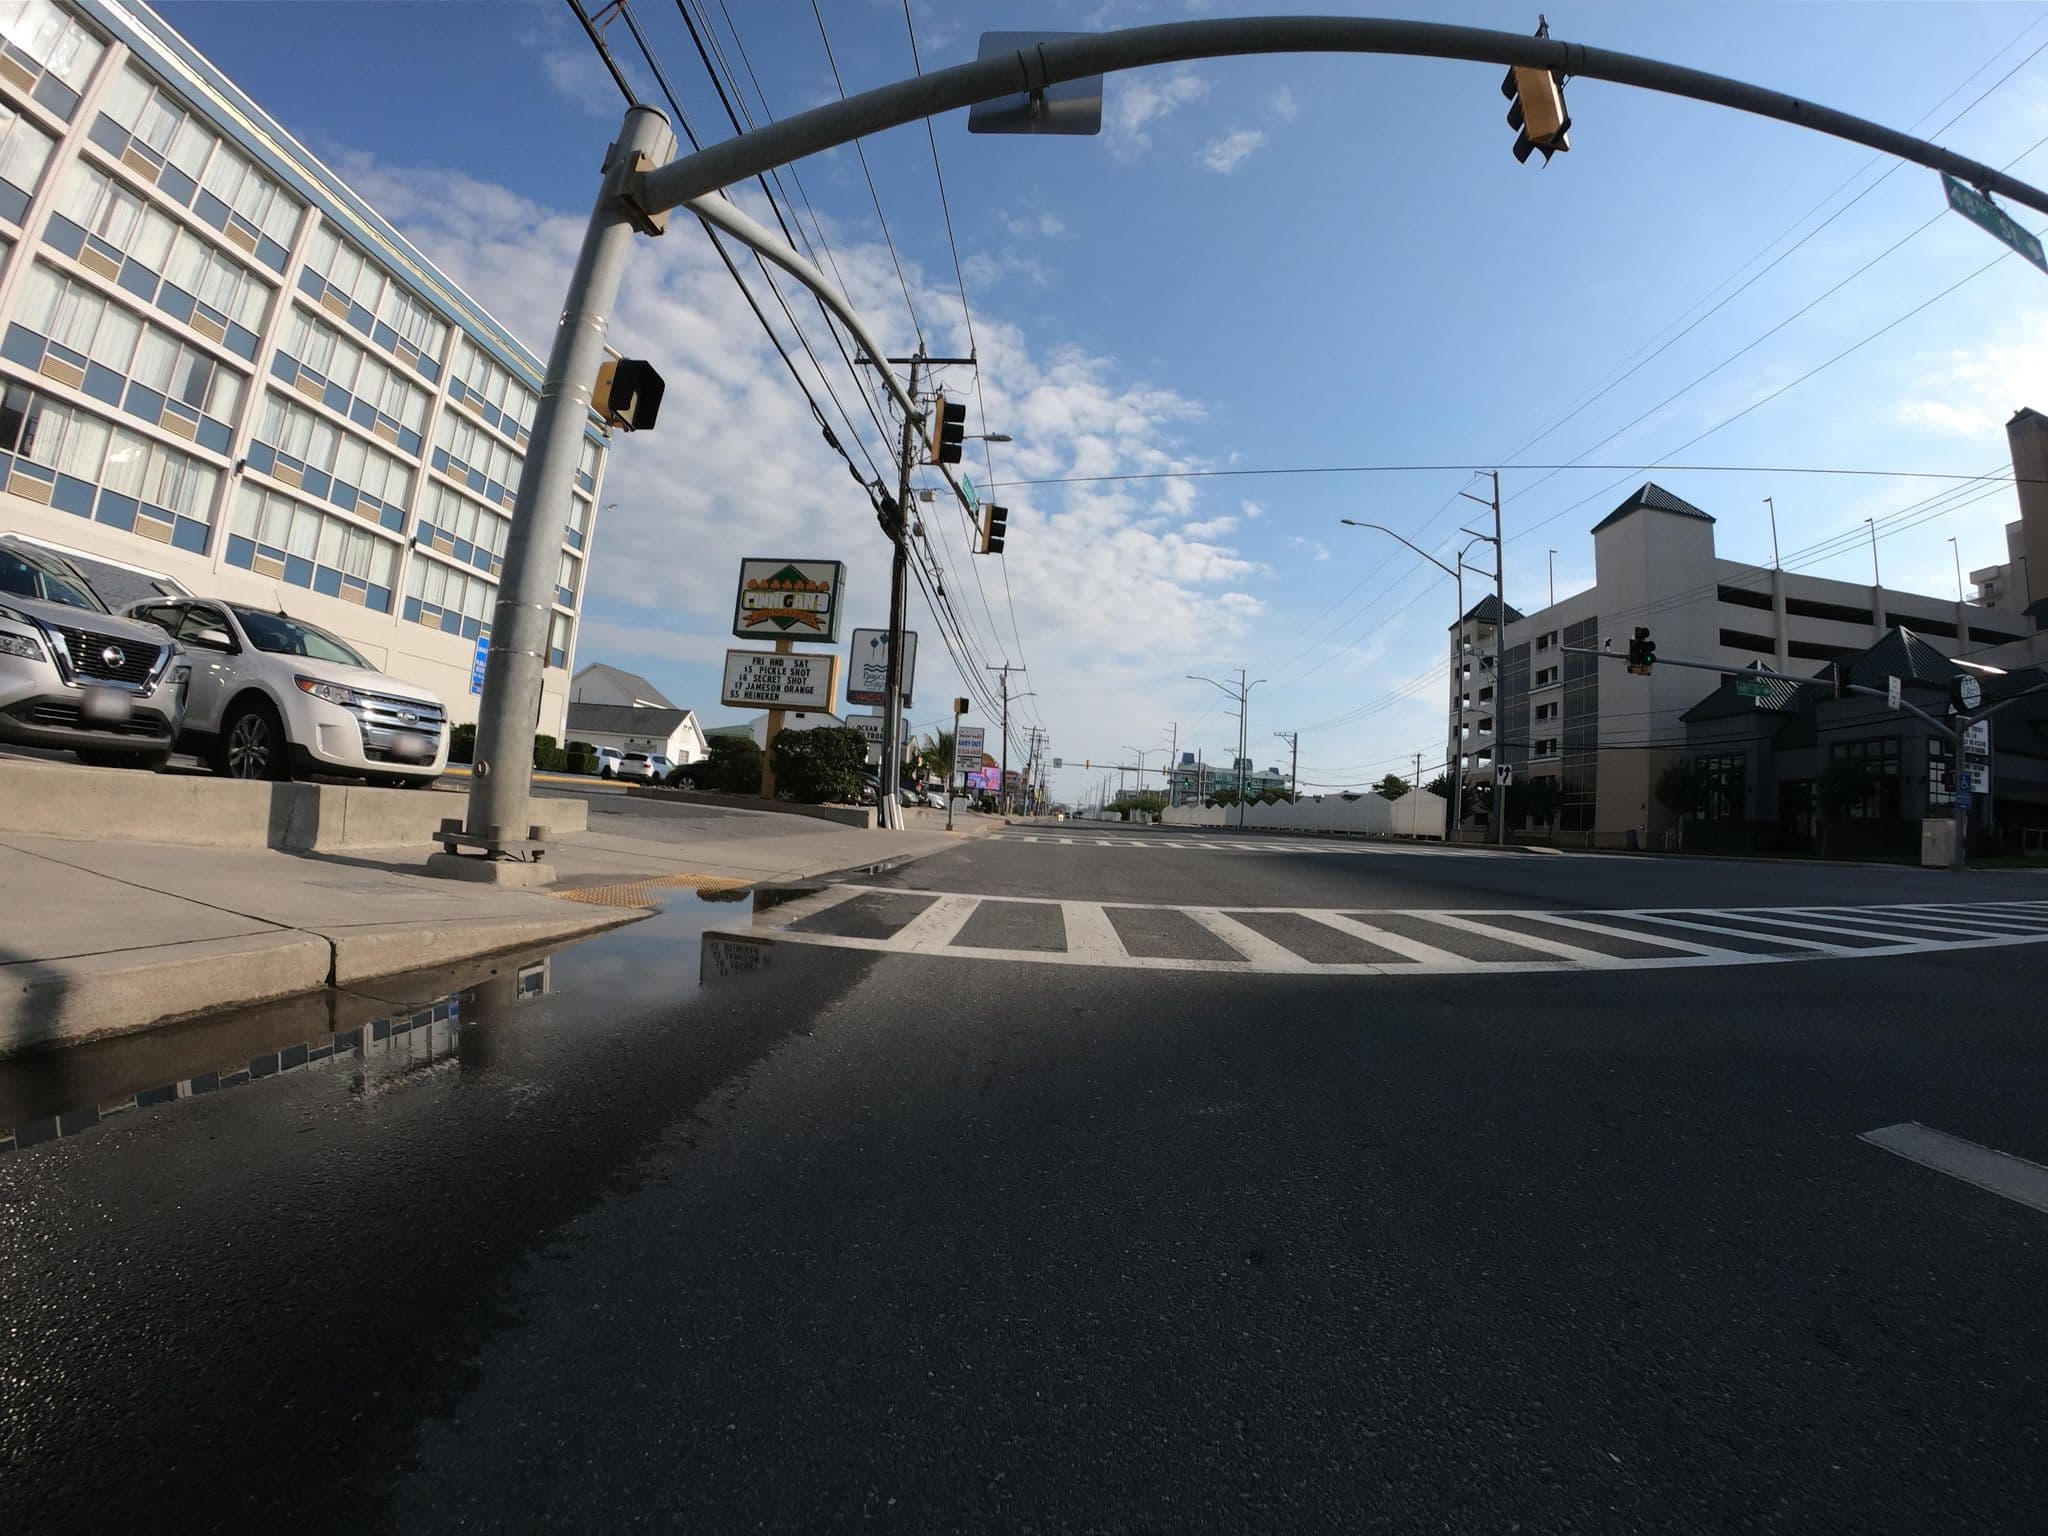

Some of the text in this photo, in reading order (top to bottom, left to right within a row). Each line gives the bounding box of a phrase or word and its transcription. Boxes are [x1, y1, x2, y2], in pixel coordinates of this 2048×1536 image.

[752, 657, 810, 668] FRI AND SAT
[759, 666, 787, 675] PICKLE
[790, 668, 811, 677] SHOT
[753, 674, 782, 683] SECRET
[787, 676, 807, 685] SHOT
[745, 682, 781, 692] JAMESON
[784, 685, 815, 694] ORANGE
[730, 690, 779, 701] $5 HEINEKEN
